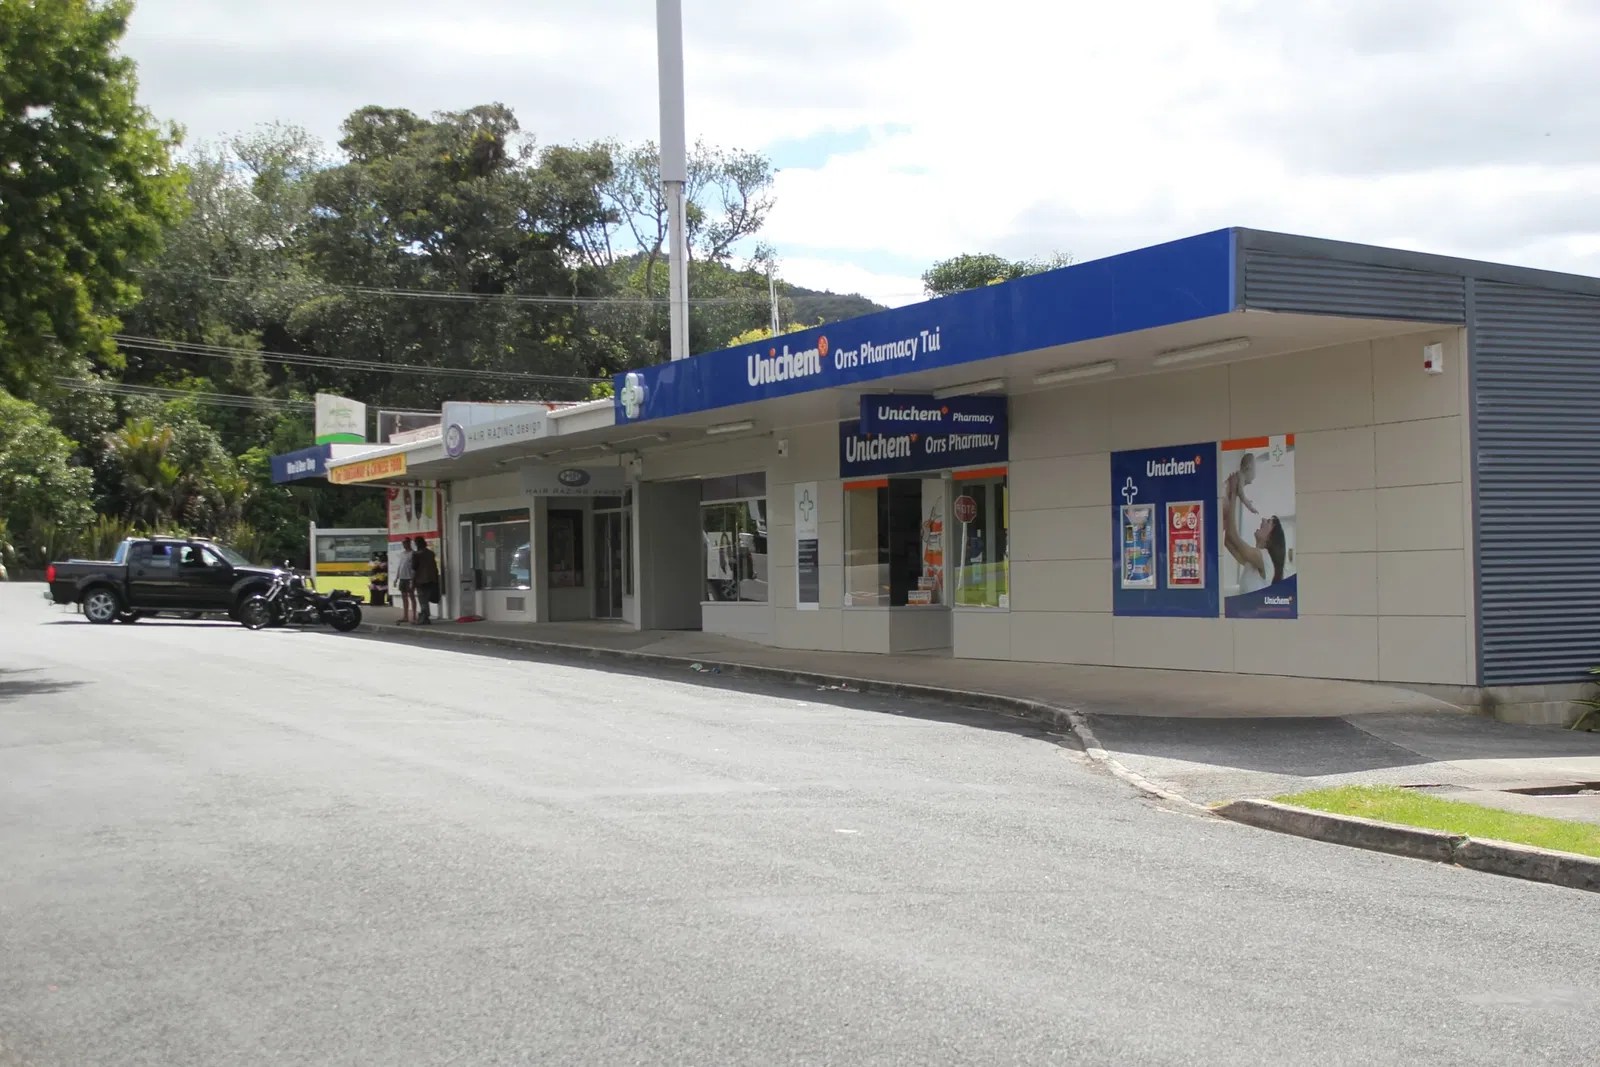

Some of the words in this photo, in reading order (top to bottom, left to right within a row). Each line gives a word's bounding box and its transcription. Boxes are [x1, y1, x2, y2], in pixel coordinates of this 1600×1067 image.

[747, 345, 821, 387] Unichem
[834, 349, 858, 370] Orrs
[860, 337, 918, 366] Pharmacy
[920, 326, 941, 354] Tui
[877, 404, 942, 422] Unichem
[952, 412, 994, 424] Pharmacy
[846, 433, 911, 463] Unichem
[925, 436, 946, 454] Orrs
[949, 434, 1000, 450] Pharmacy
[1146, 457, 1196, 477] Unichem
[1264, 596, 1290, 605] Unichem
